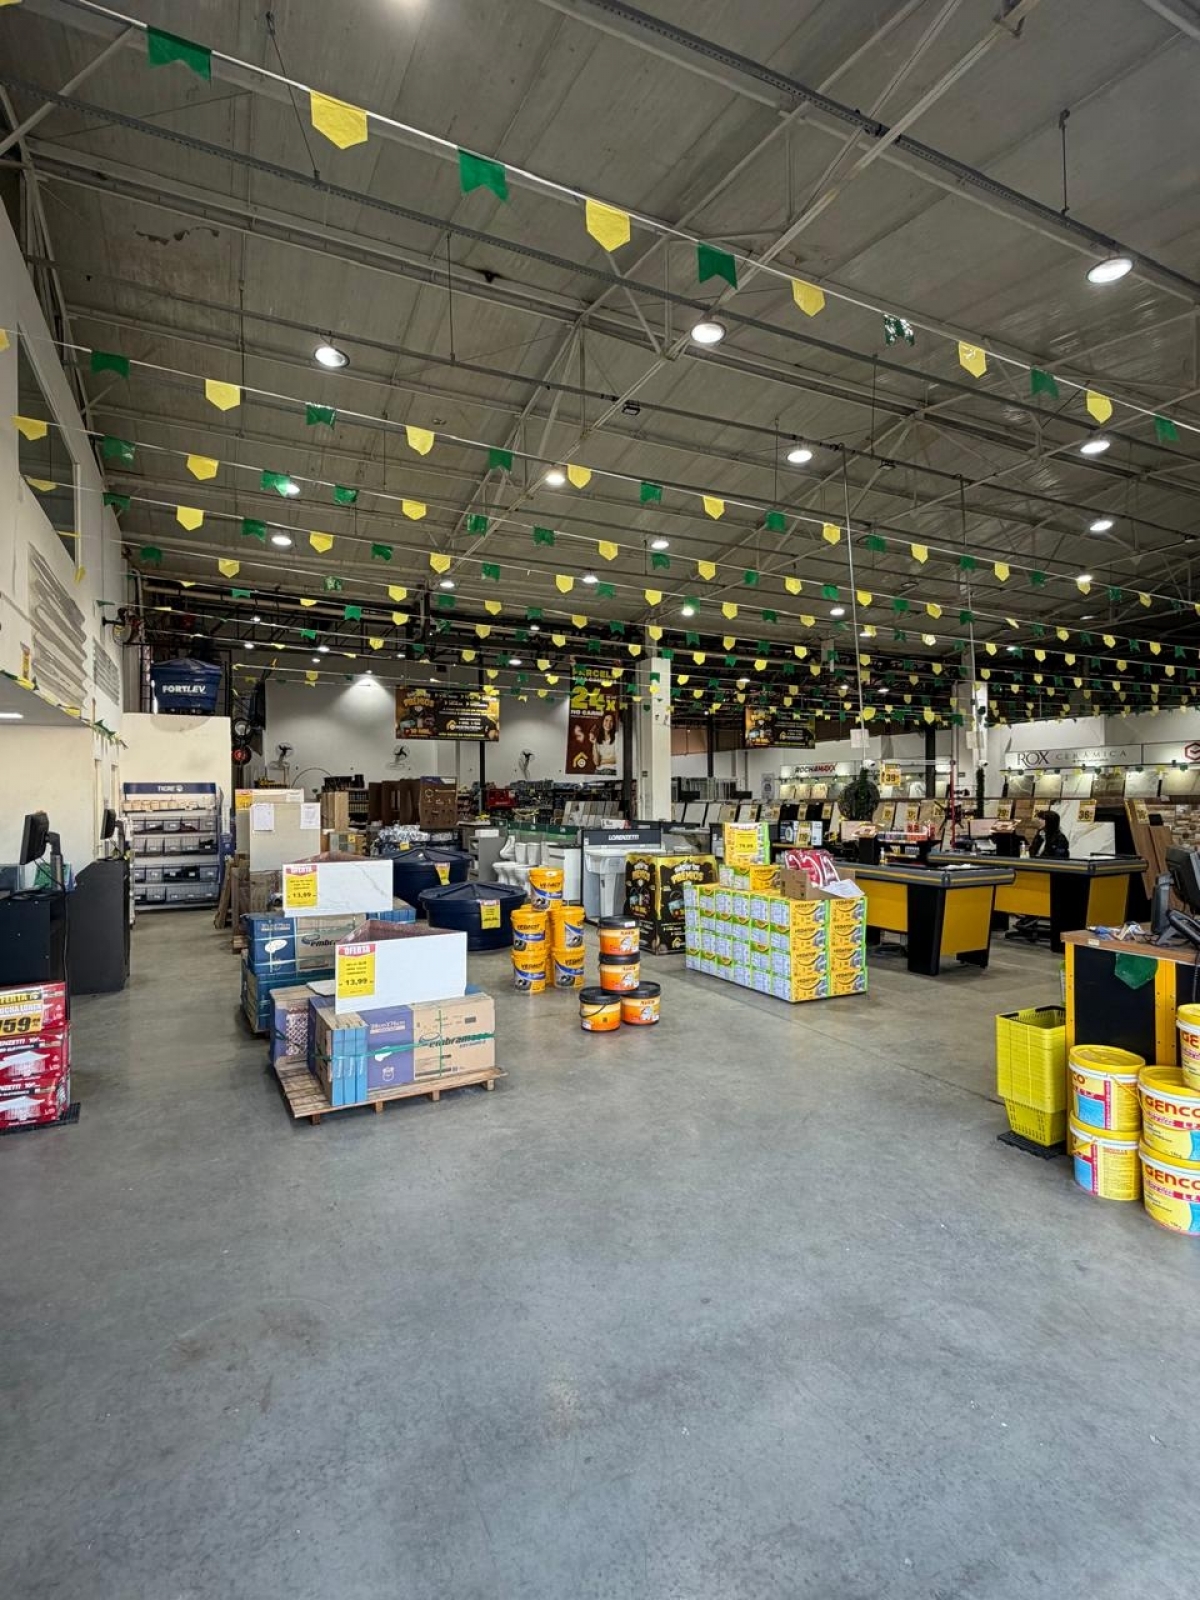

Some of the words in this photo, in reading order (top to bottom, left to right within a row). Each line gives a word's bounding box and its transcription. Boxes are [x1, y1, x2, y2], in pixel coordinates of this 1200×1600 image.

[162, 685, 206, 695] FORTLEV
[1017, 750, 1050, 768] ROX
[0, 1016, 31, 1033] 59
